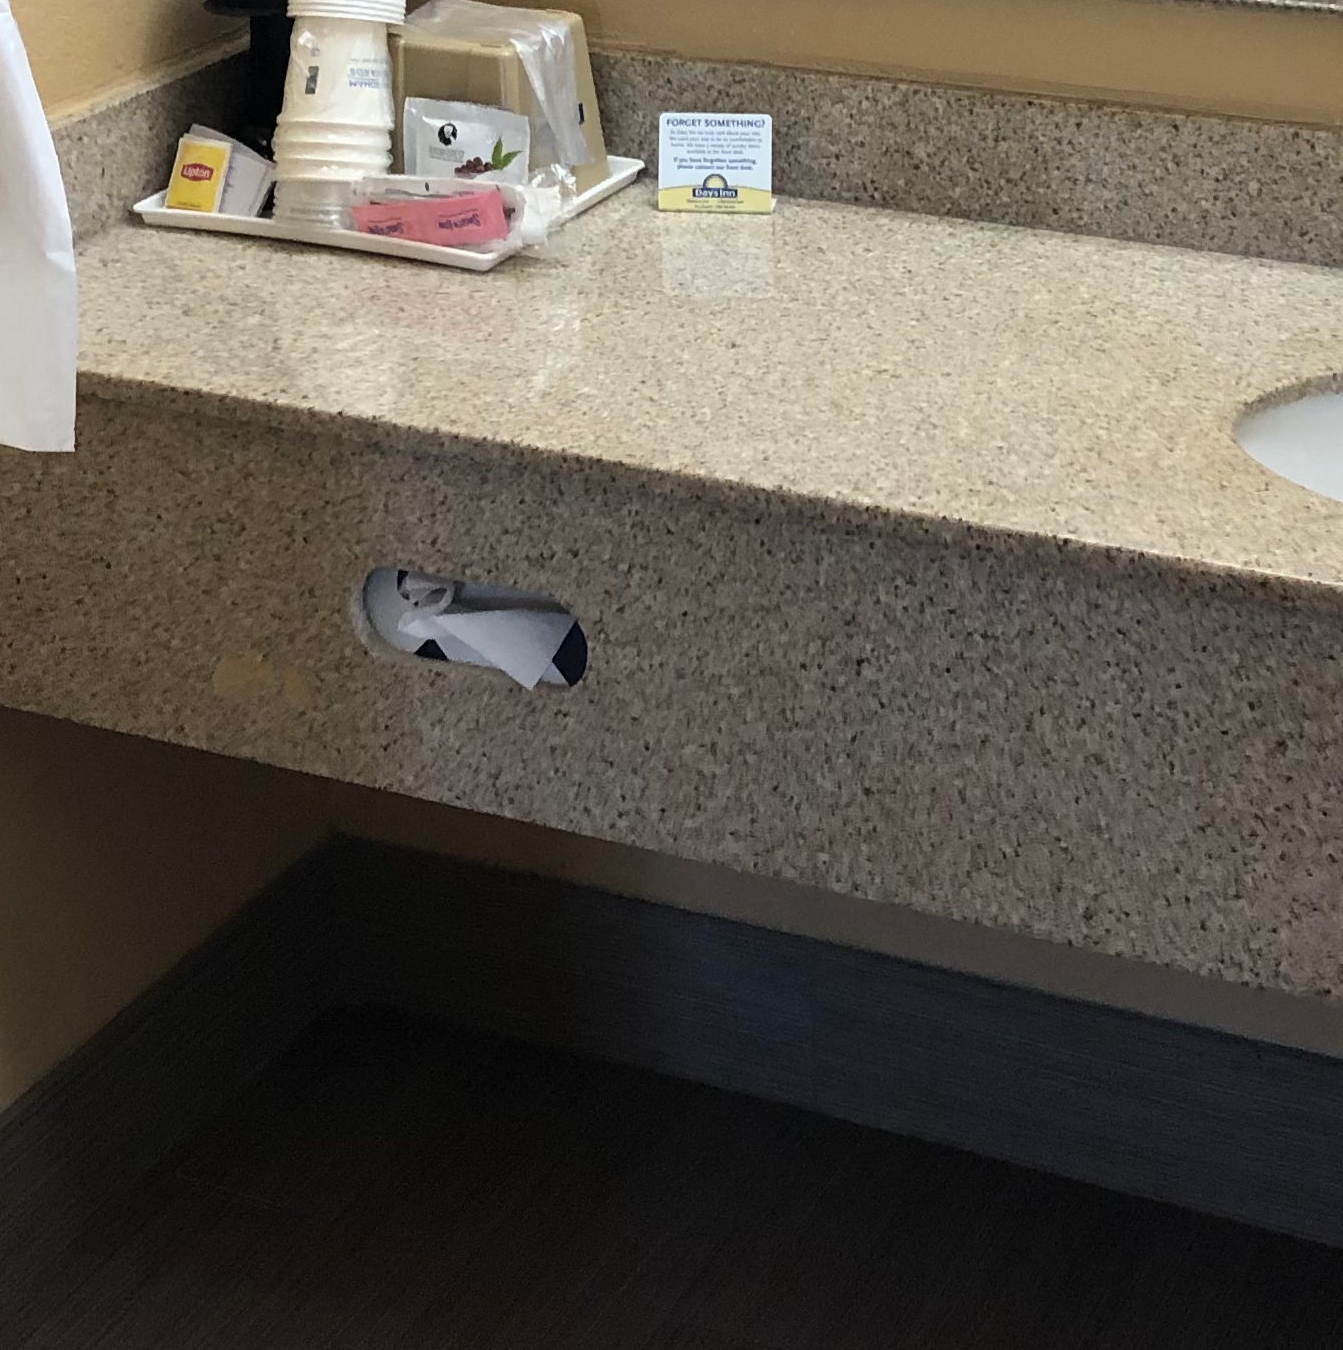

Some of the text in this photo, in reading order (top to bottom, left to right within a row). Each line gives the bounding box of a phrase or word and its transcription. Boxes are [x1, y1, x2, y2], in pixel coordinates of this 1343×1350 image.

[667, 119, 765, 128] FORGET SOMETHING?
[183, 166, 210, 178] Lipton
[695, 190, 718, 198] Days
